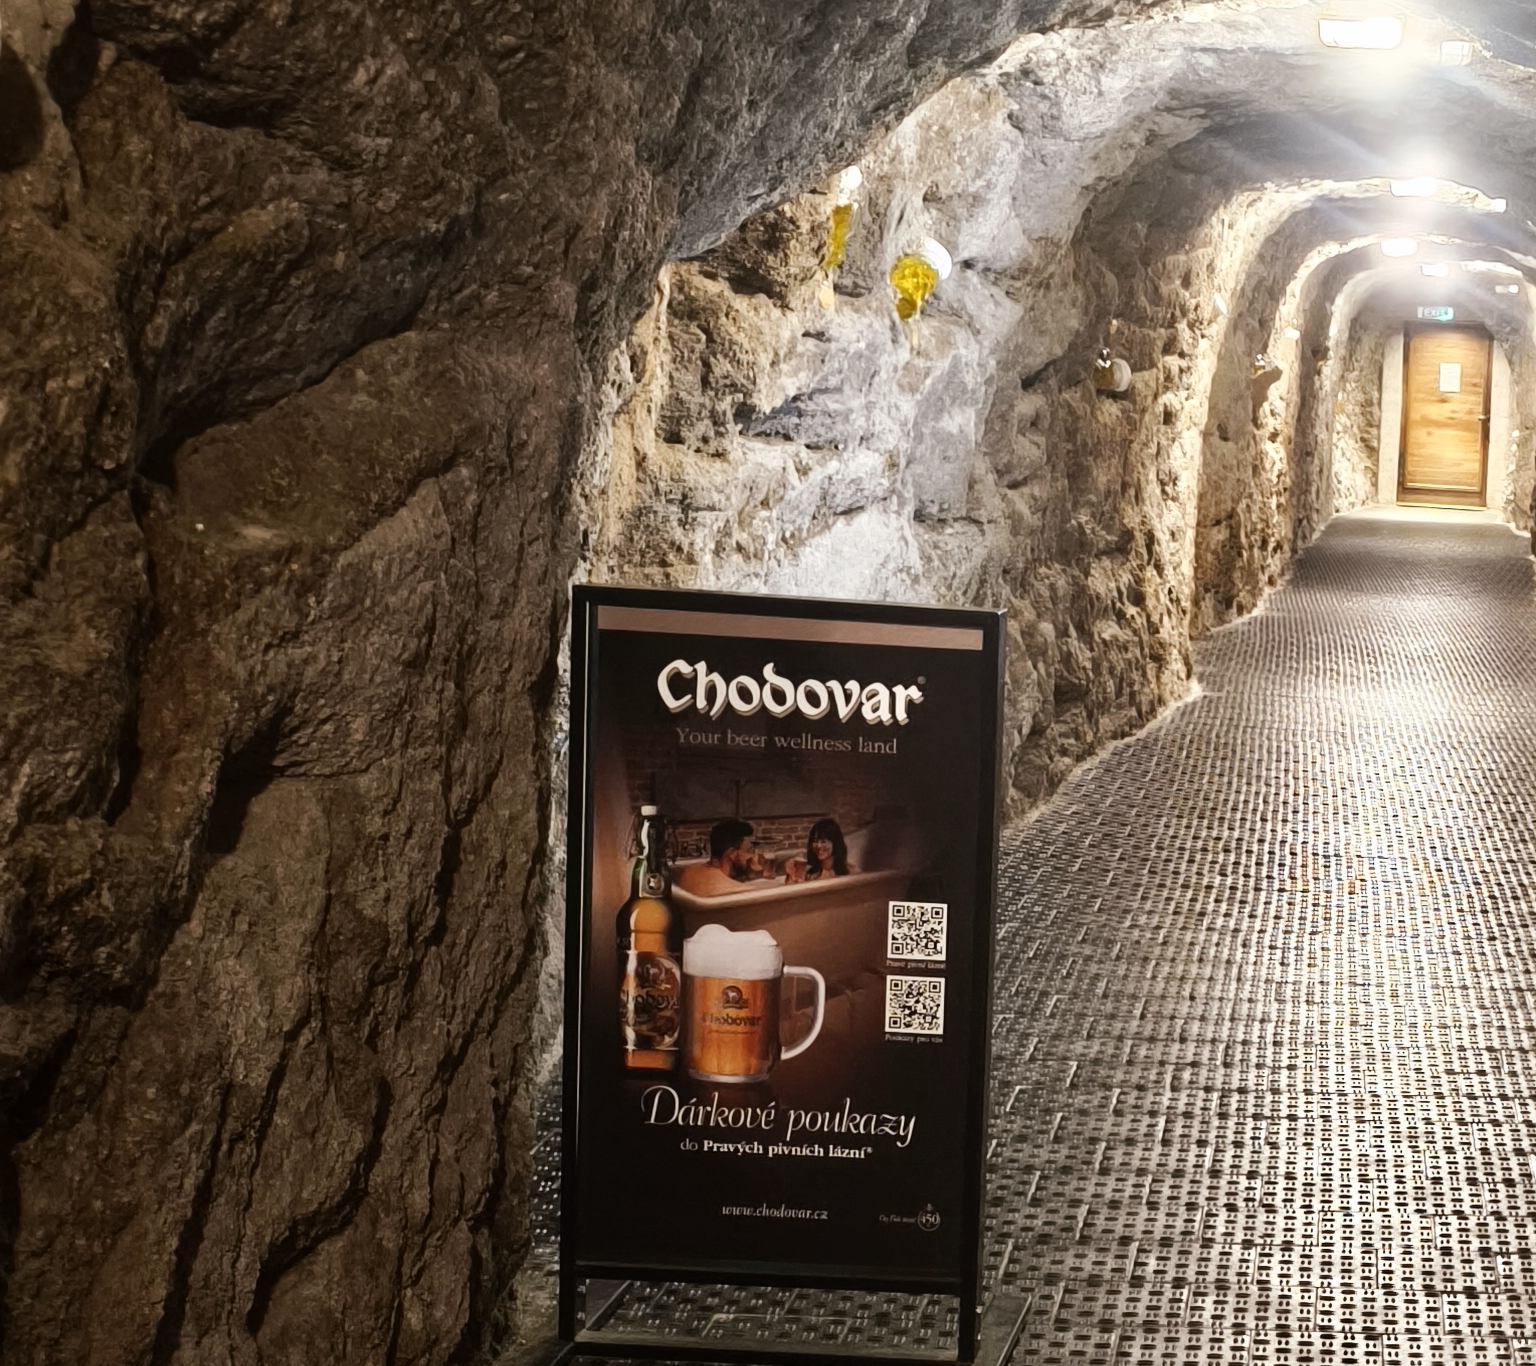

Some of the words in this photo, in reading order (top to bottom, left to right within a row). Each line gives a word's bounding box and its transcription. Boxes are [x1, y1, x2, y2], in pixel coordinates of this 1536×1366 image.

[675, 727, 721, 746] Your
[726, 729, 767, 748] beer
[774, 733, 853, 752] wellness
[858, 736, 898, 755] land
[640, 1085, 776, 1130] Dárkové
[786, 1097, 917, 1147] poukazy
[680, 1138, 699, 1151] do
[703, 1139, 764, 1156] Pravých
[768, 1143, 824, 1158] pivních
[722, 1202, 829, 1220] www.chodovar.cz
